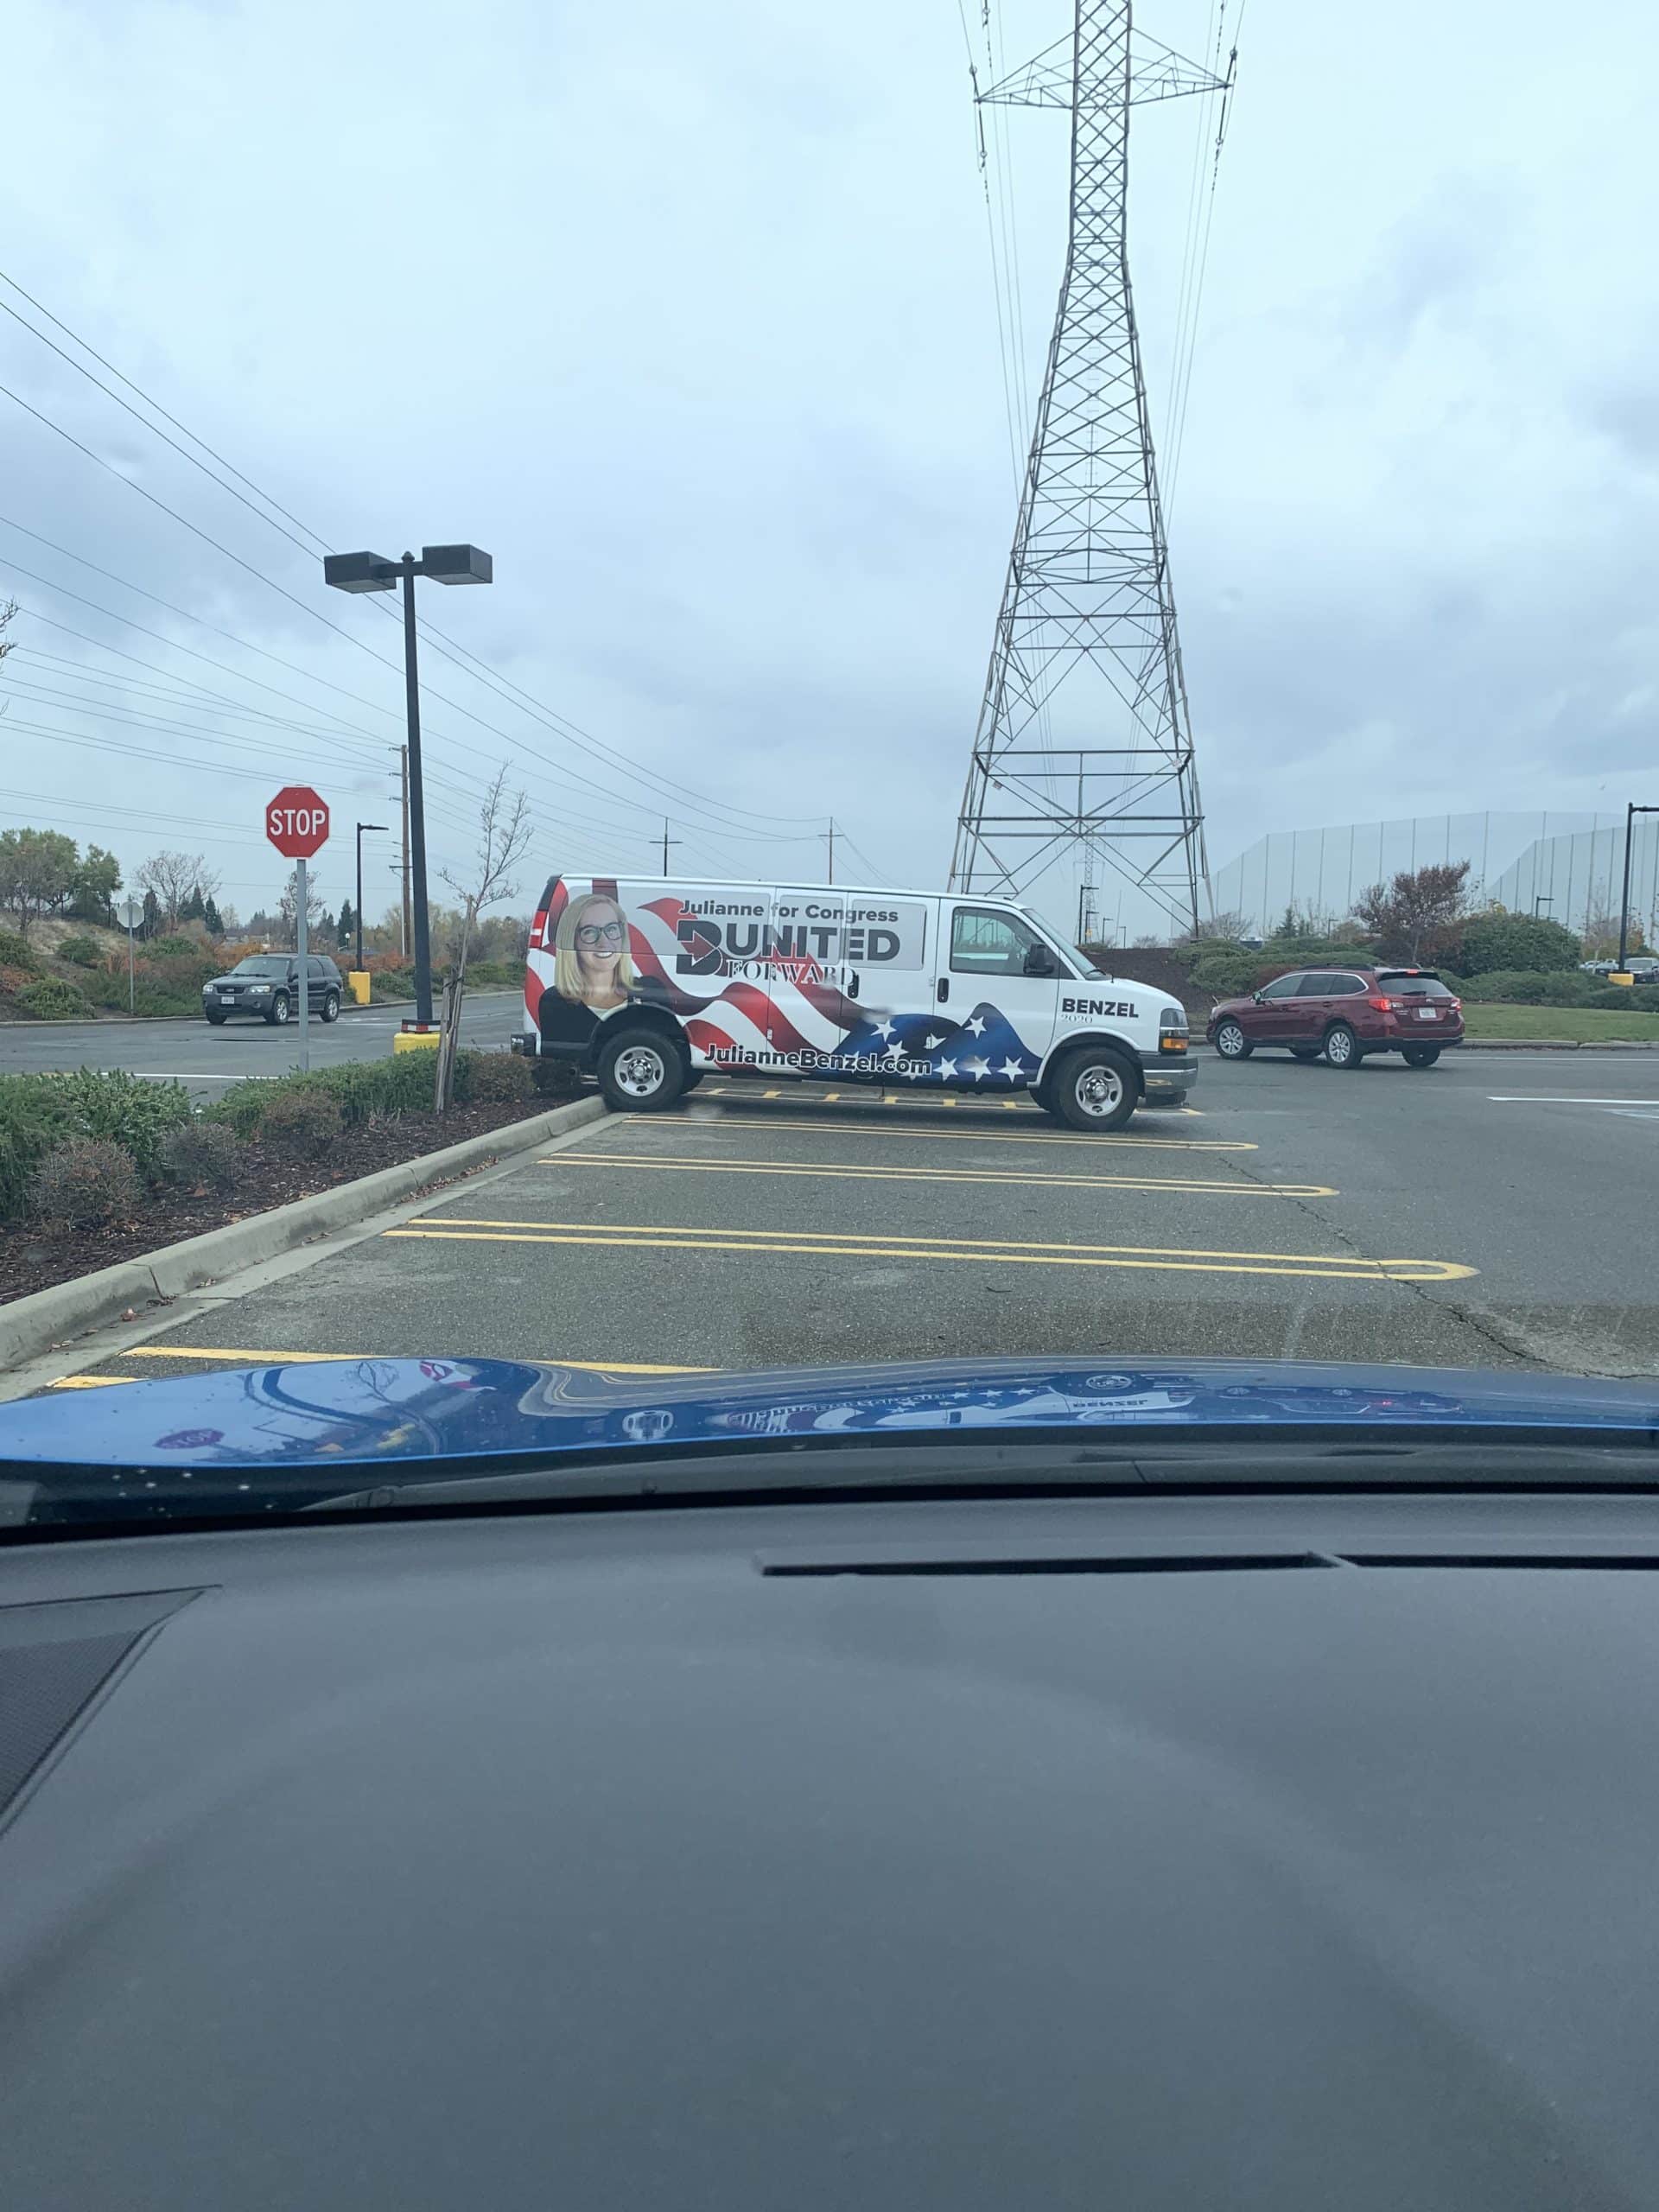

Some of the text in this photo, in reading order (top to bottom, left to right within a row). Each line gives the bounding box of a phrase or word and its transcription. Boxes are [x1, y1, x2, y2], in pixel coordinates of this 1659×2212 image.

[270, 809, 326, 836] STOP
[679, 899, 899, 924] Julianne for Congress
[726, 923, 900, 962] UNITED
[726, 959, 856, 986] FORWARD
[1061, 1014, 1093, 1024] 2020
[1062, 998, 1139, 1019] BENZEL
[703, 1043, 932, 1075] JulianneBenzel.com
